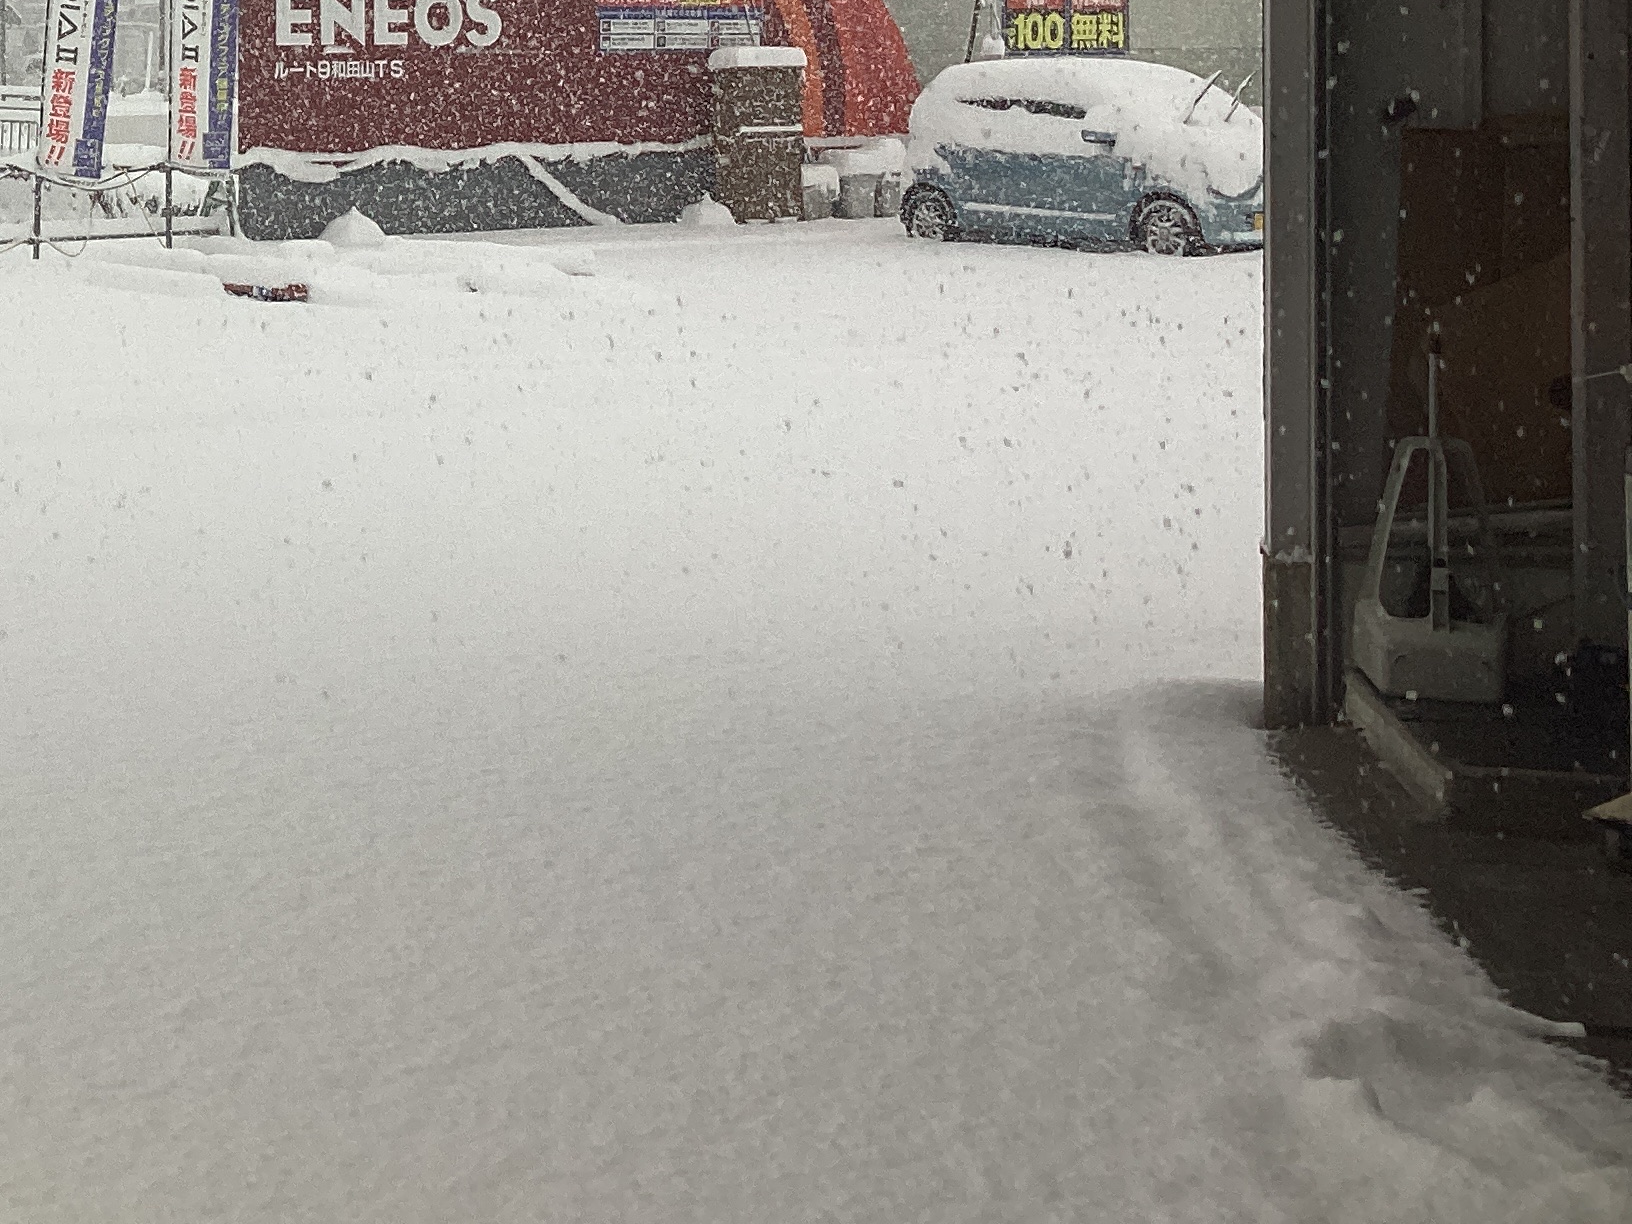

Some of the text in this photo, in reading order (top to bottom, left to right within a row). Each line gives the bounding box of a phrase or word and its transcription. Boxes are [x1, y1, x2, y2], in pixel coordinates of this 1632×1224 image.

[1014, 11, 1065, 50] 100
[1070, 11, 1124, 49] 無料
[44, 68, 76, 167] 新登場!!
[176, 66, 198, 161] 新登場!!
